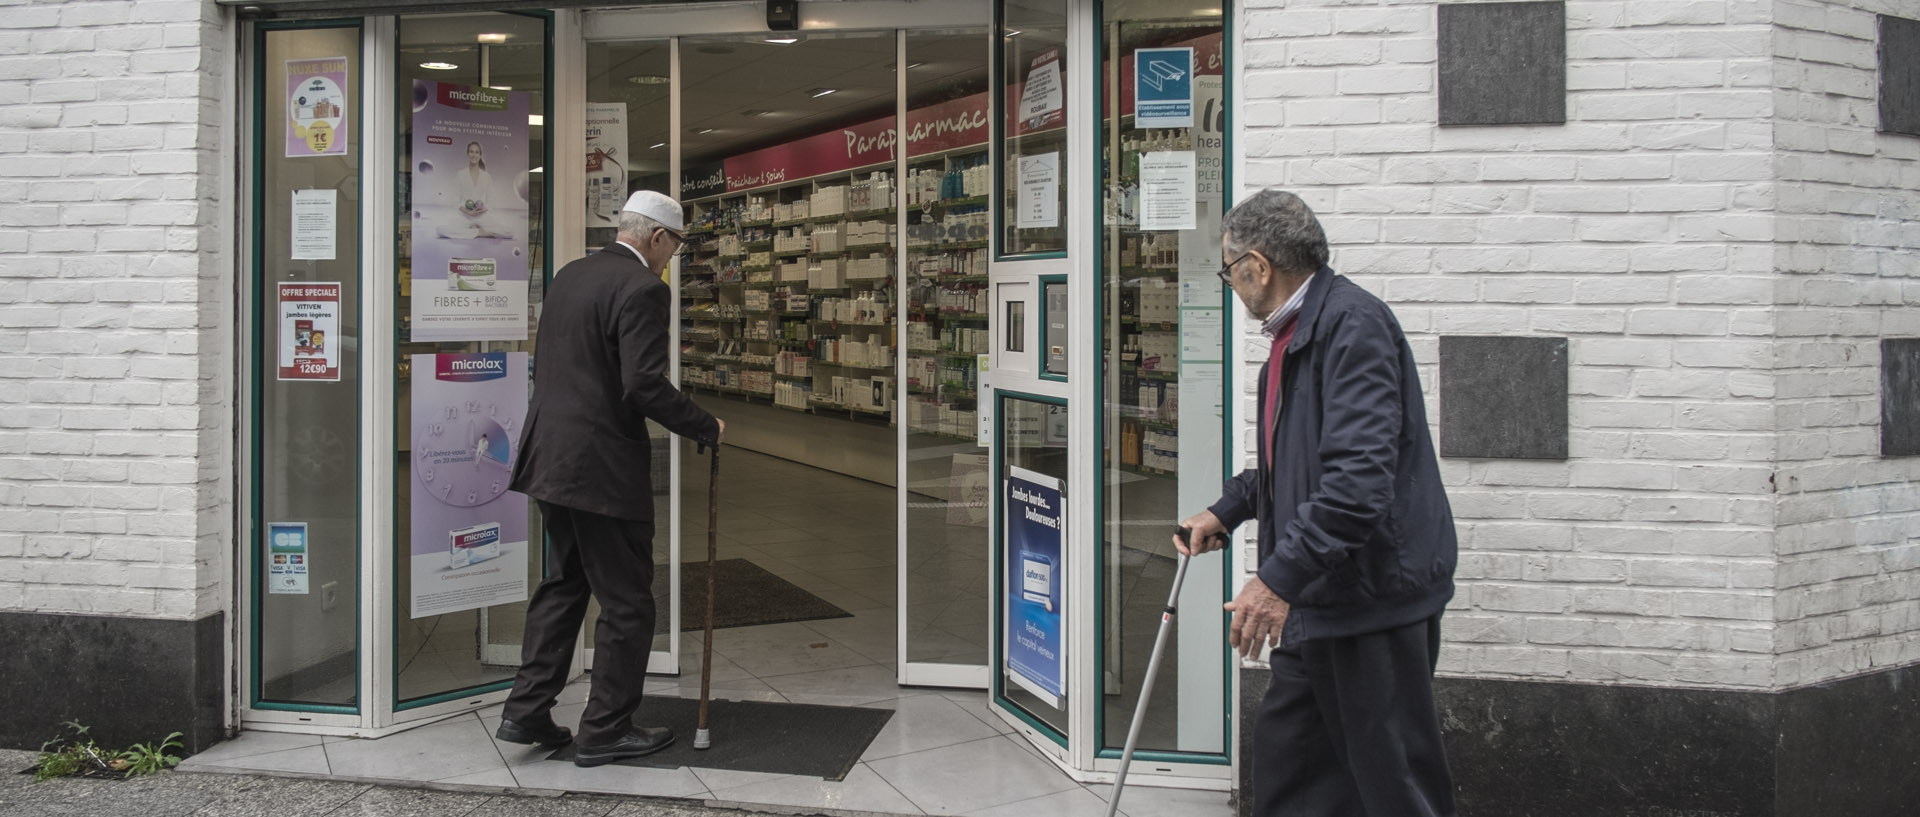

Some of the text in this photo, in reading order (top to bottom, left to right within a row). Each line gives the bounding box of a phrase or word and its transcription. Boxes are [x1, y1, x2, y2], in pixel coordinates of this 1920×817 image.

[282, 288, 337, 297] OFFRE SPECIALE
[434, 296, 470, 308] FIBRES
[300, 364, 326, 374] 12€90
[452, 358, 503, 370] microlax
[1012, 486, 1028, 502] Jambes
[1026, 506, 1056, 528] Douloureuses
[275, 533, 302, 546] CB
[464, 530, 498, 542] microlax
